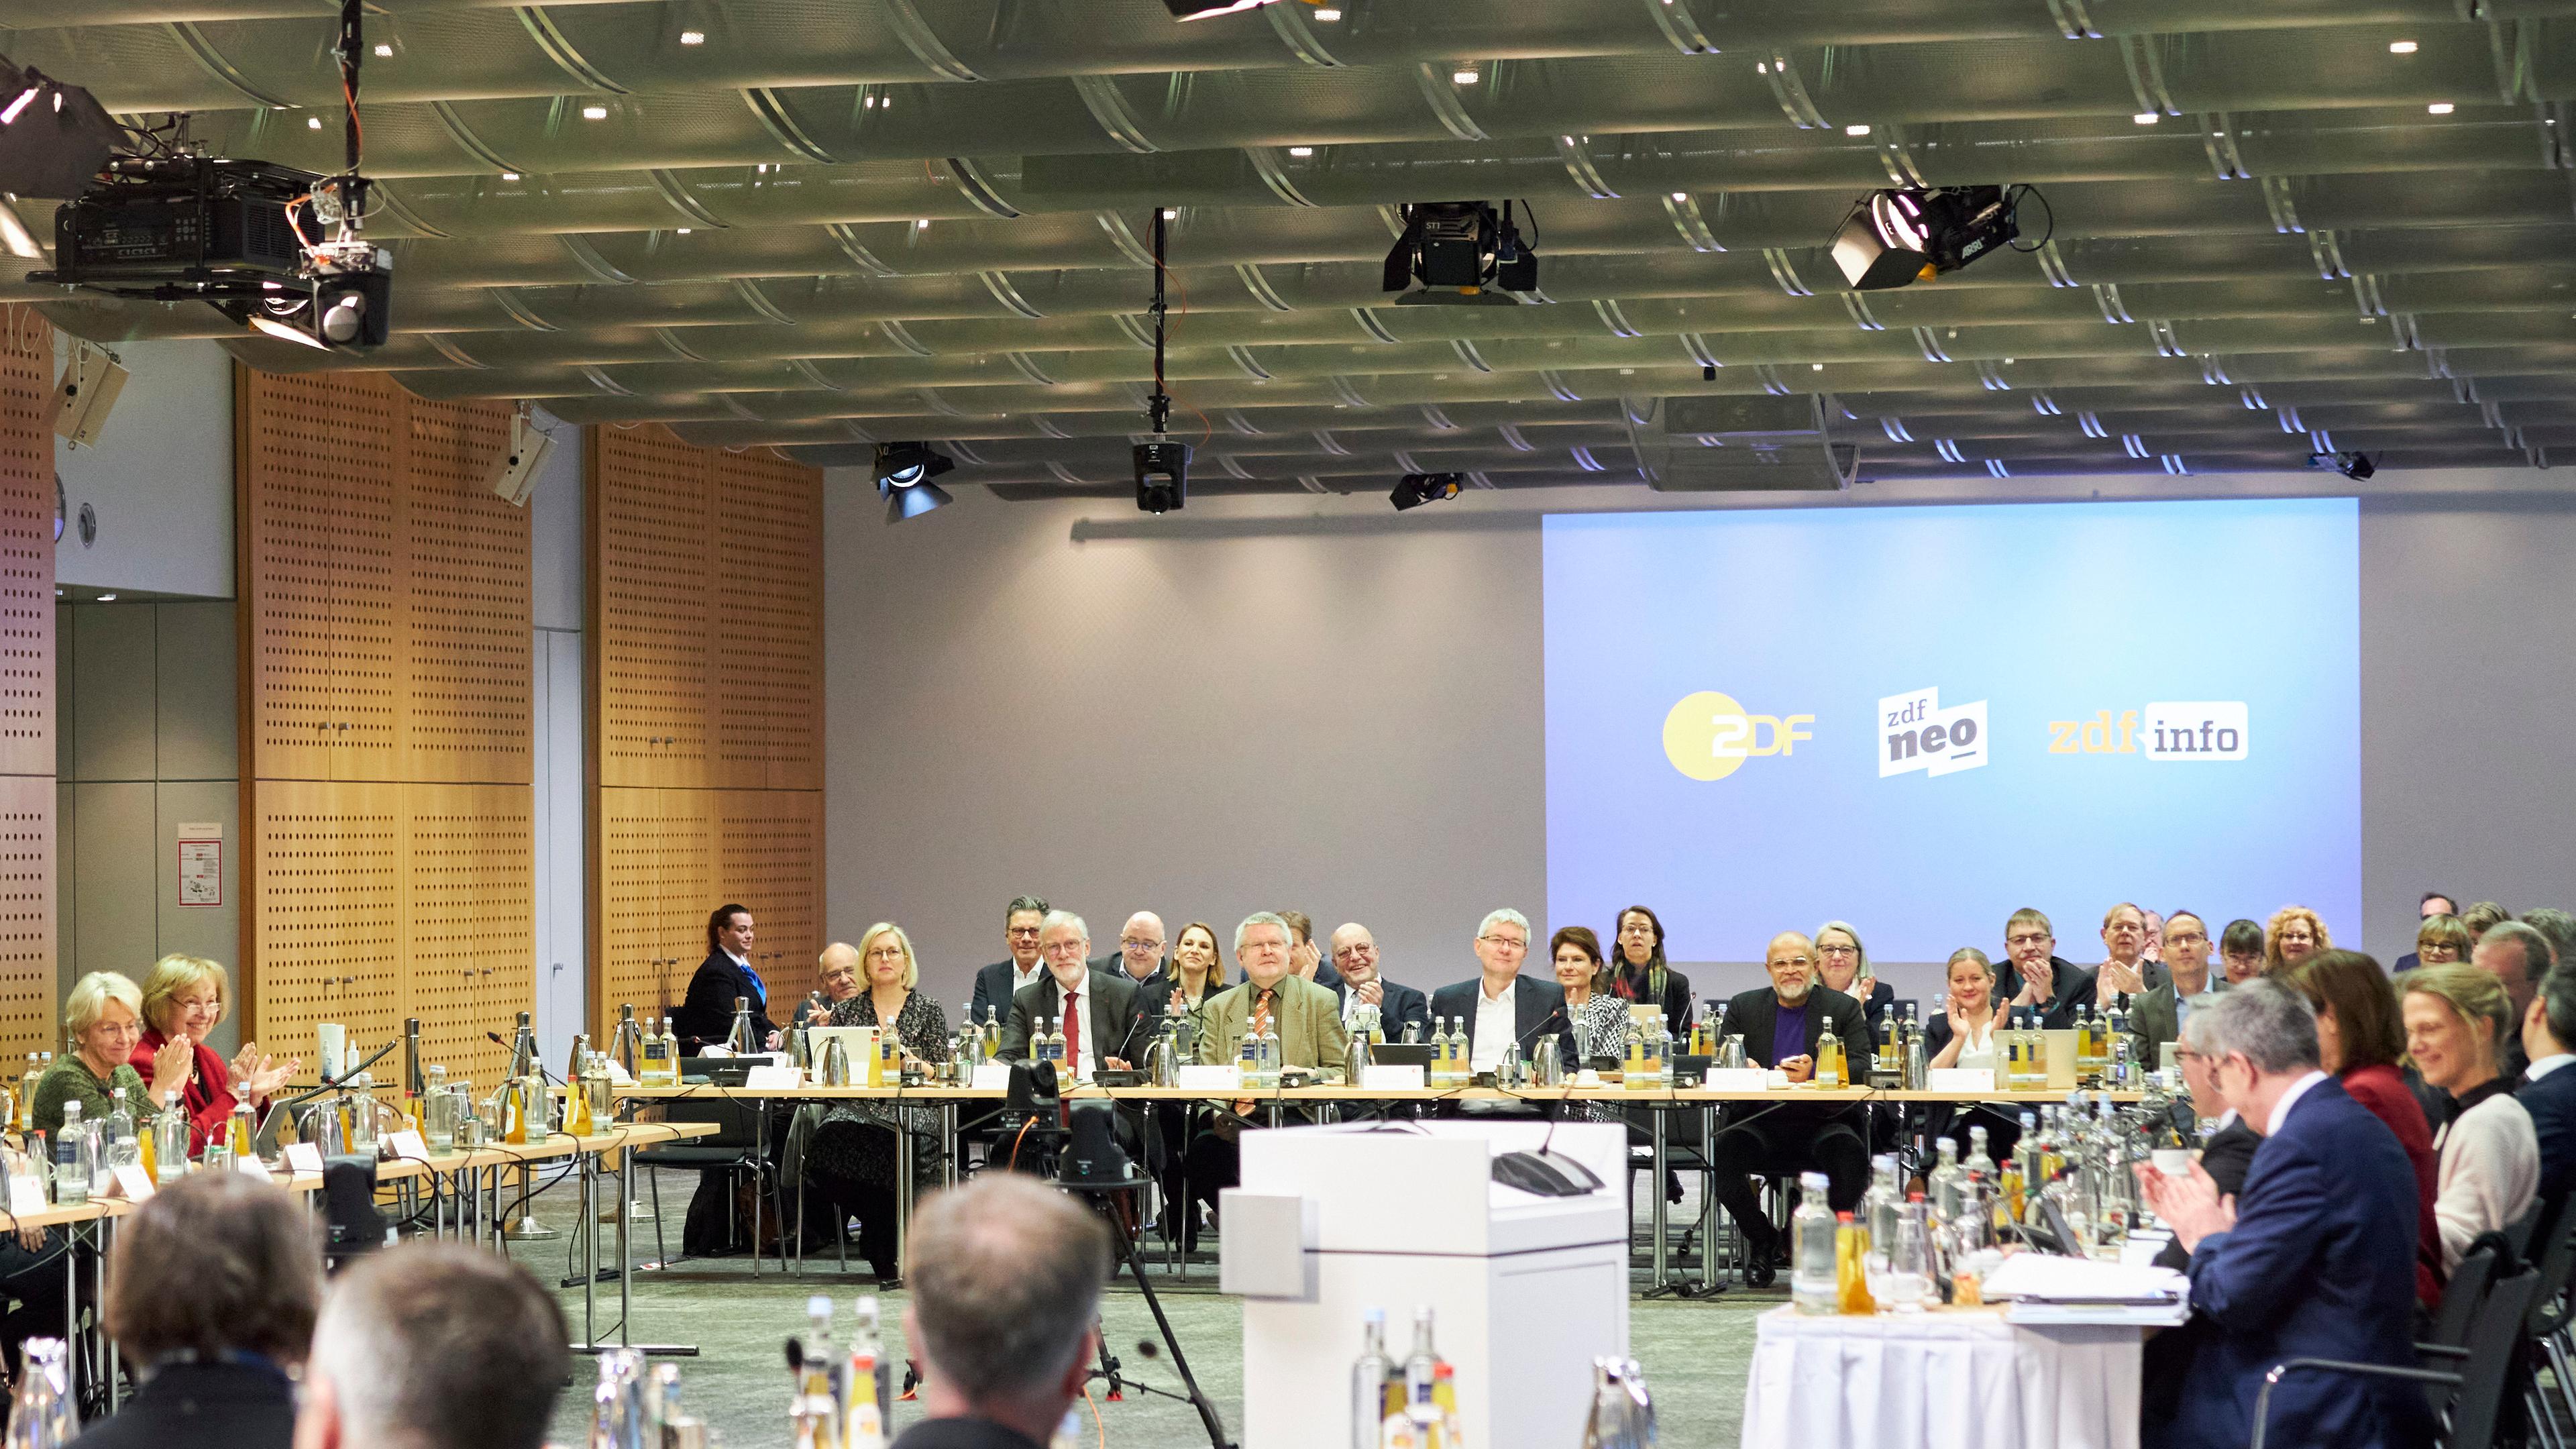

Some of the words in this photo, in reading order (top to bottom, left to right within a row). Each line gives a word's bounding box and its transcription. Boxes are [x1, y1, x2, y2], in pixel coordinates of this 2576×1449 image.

[1962, 239, 1984, 260] ARRI
[1888, 698, 1927, 727] zdf
[2048, 709, 2139, 754] zdf
[2154, 719, 2240, 753] info
[1713, 714, 1815, 758] ZDF
[1888, 718, 1978, 762] neo
